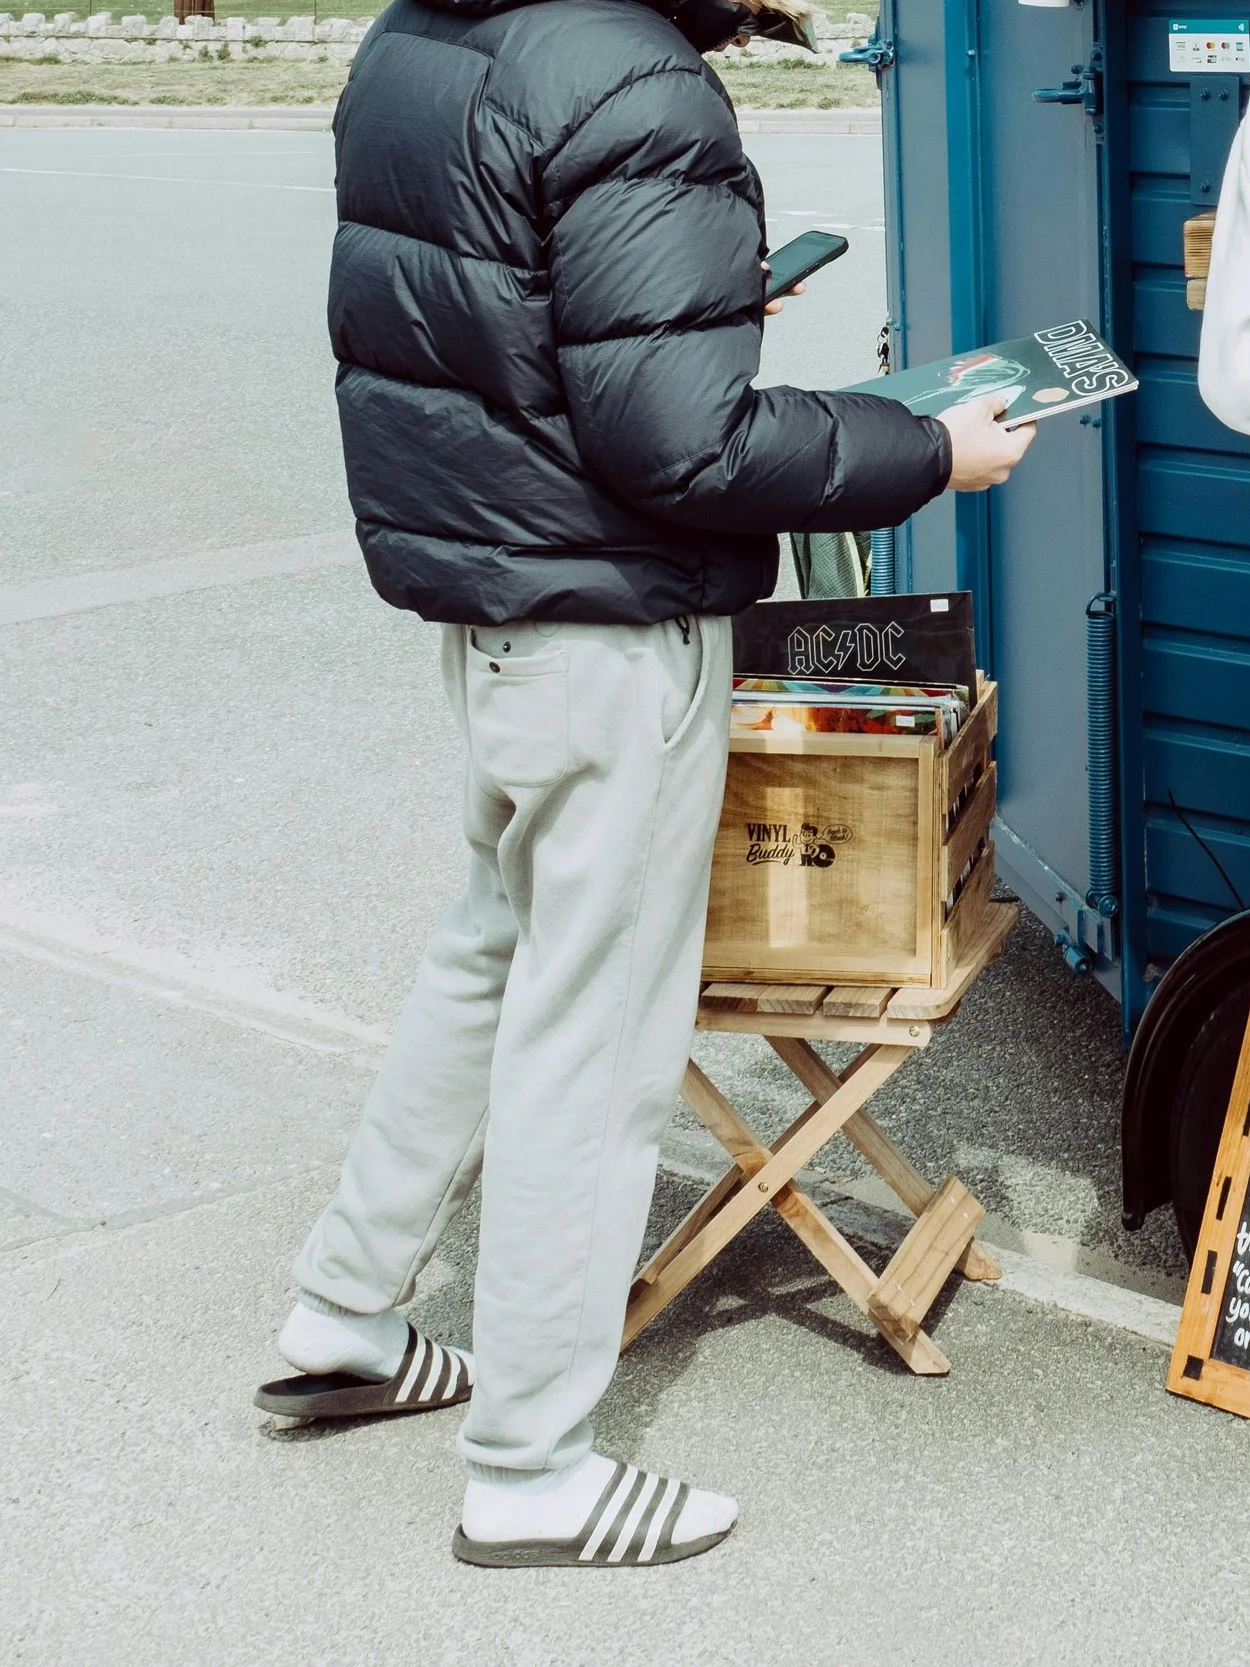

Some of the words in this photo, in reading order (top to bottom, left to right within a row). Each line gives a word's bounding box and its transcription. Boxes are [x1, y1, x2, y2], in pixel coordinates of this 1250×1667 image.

[1034, 319, 1129, 396] DMA'S
[746, 823, 791, 842] VINYL
[746, 843, 795, 866] Buddy
